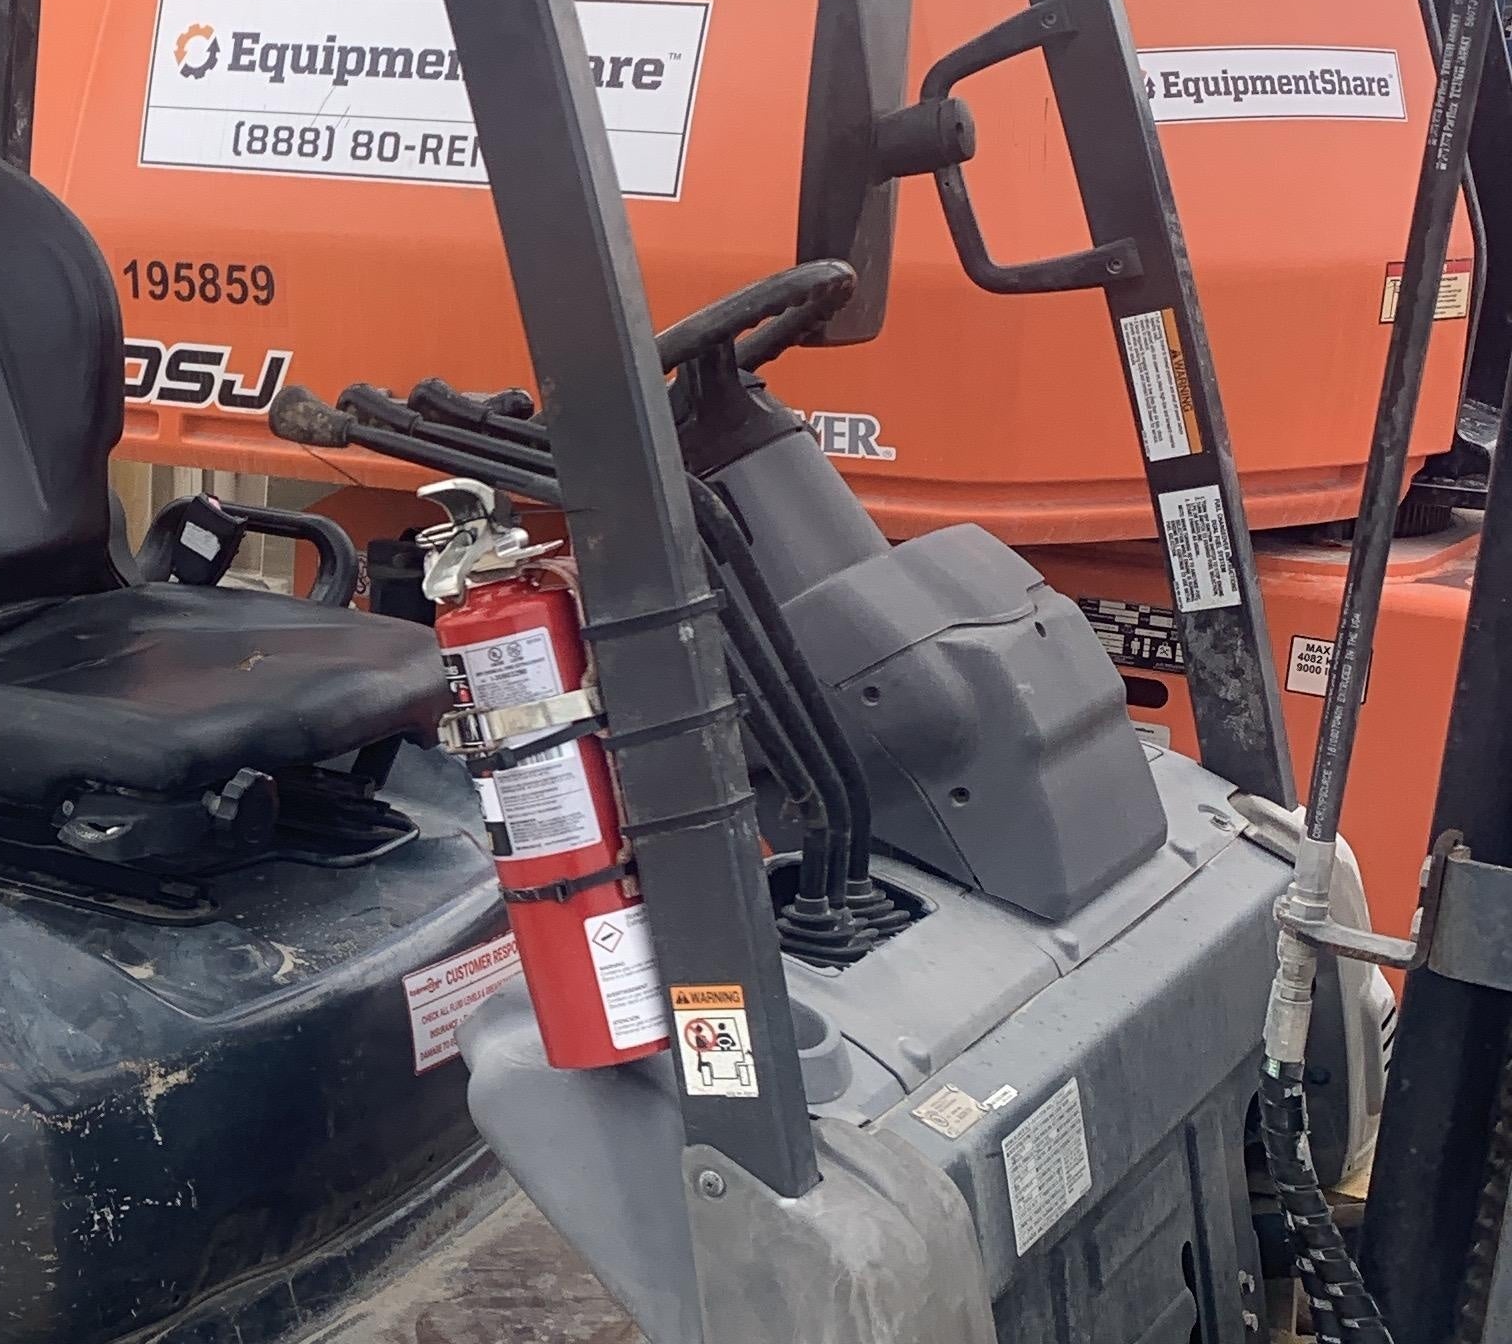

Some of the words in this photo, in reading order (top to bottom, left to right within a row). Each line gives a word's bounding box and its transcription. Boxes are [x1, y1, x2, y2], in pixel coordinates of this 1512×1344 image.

[227, 31, 665, 91] Equipmere
[1159, 68, 1391, 104] EquipmentShare
[232, 119, 336, 162] (888)
[122, 258, 276, 306] 195859
[1171, 358, 1195, 413] WARNING
[1297, 652, 1323, 664] 4082
[1305, 643, 1331, 655] MAX
[1296, 662, 1322, 674] 9000
[445, 952, 493, 985] CUSTOMER
[690, 990, 741, 1005] WARNING
